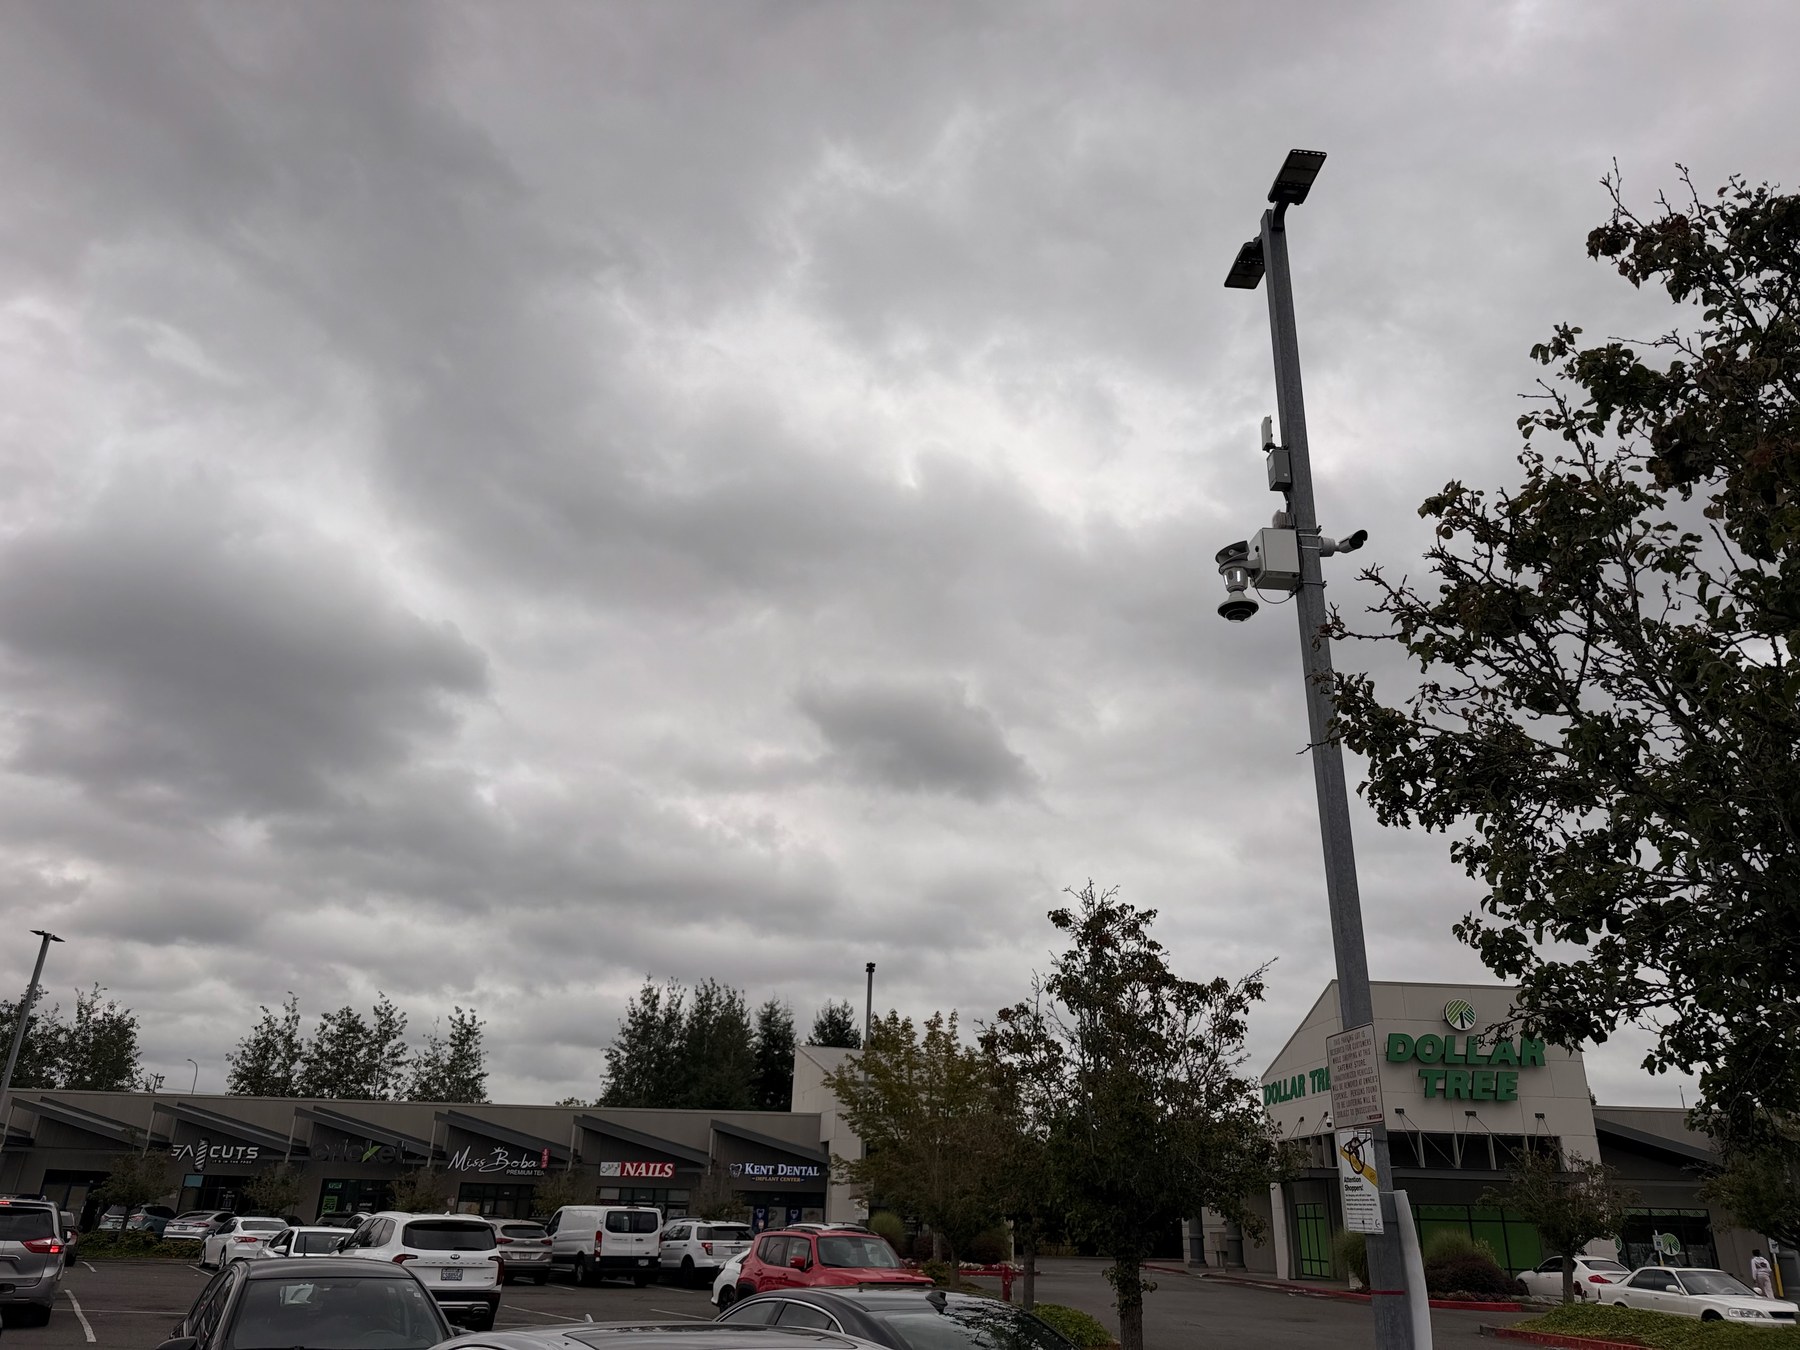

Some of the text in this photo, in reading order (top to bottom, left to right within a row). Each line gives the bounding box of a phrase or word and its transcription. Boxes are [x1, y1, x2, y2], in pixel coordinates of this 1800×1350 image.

[1386, 1033, 1546, 1067] DOLLAR
[1337, 1063, 1352, 1071] SAFEWAY
[1263, 1066, 1331, 1106] DOLLAR TRE
[1418, 1069, 1520, 1101] TREE
[209, 1144, 260, 1160] CUTS
[311, 1139, 407, 1164] cricket
[447, 1145, 487, 1172] Miss
[478, 1149, 539, 1172] Boba
[622, 1162, 674, 1178] NAILS
[744, 1163, 820, 1176] KENT DENTAL
